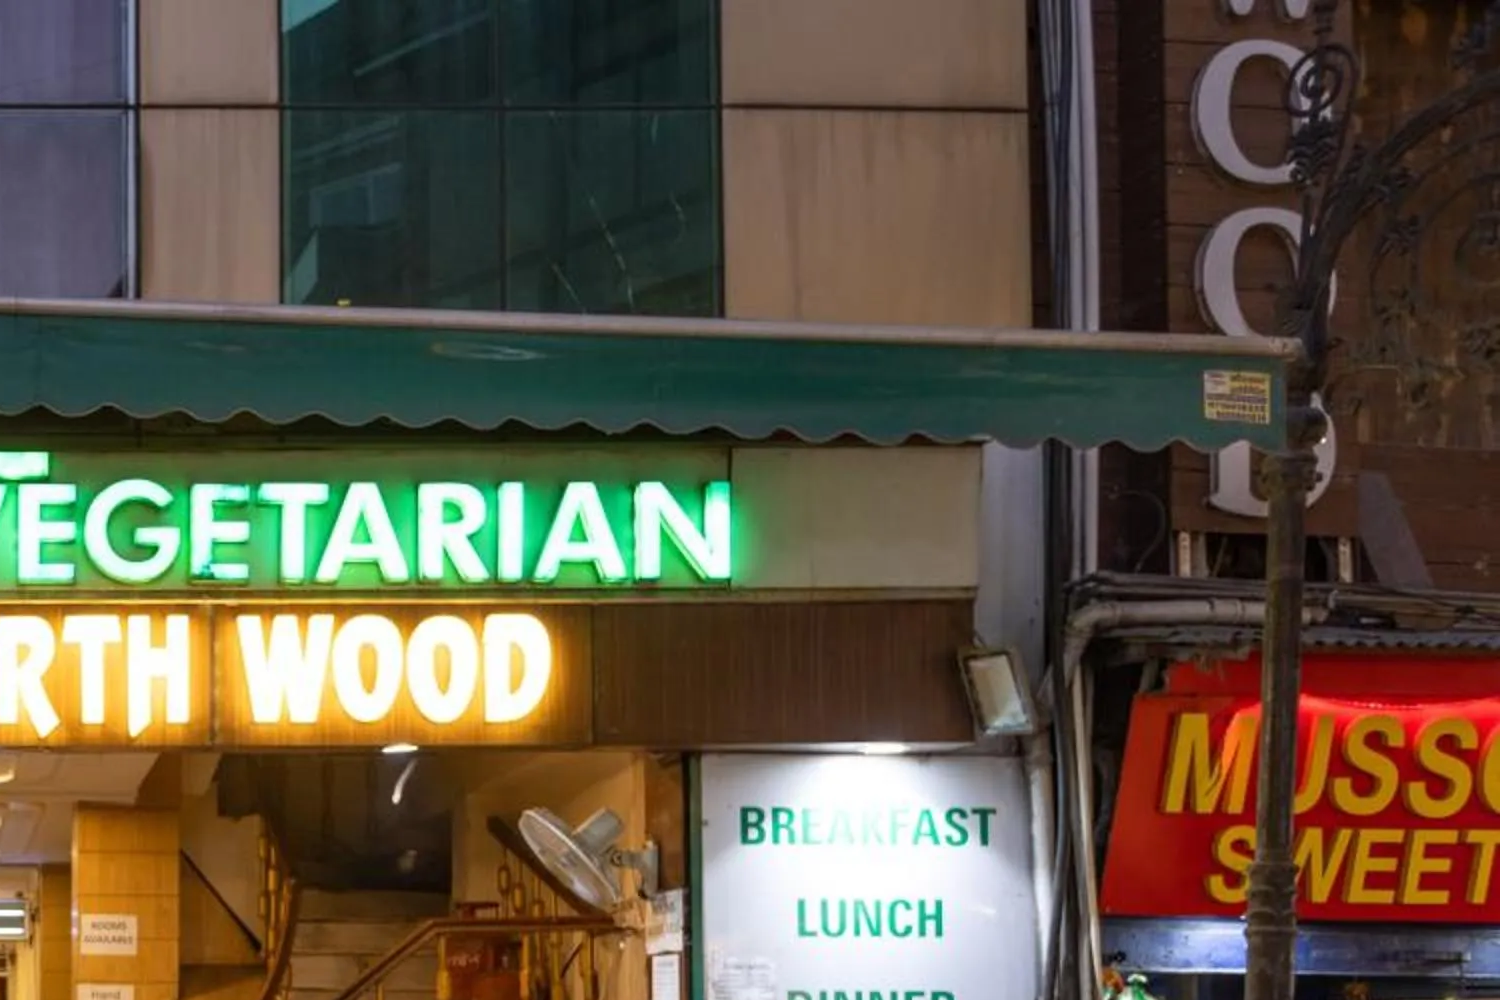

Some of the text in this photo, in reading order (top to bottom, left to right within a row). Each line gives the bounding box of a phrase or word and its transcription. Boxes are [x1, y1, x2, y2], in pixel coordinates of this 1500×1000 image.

[236, 612, 553, 727] WOOD
[739, 807, 997, 847] BREAKFAST
[797, 899, 943, 938] LUNCH
